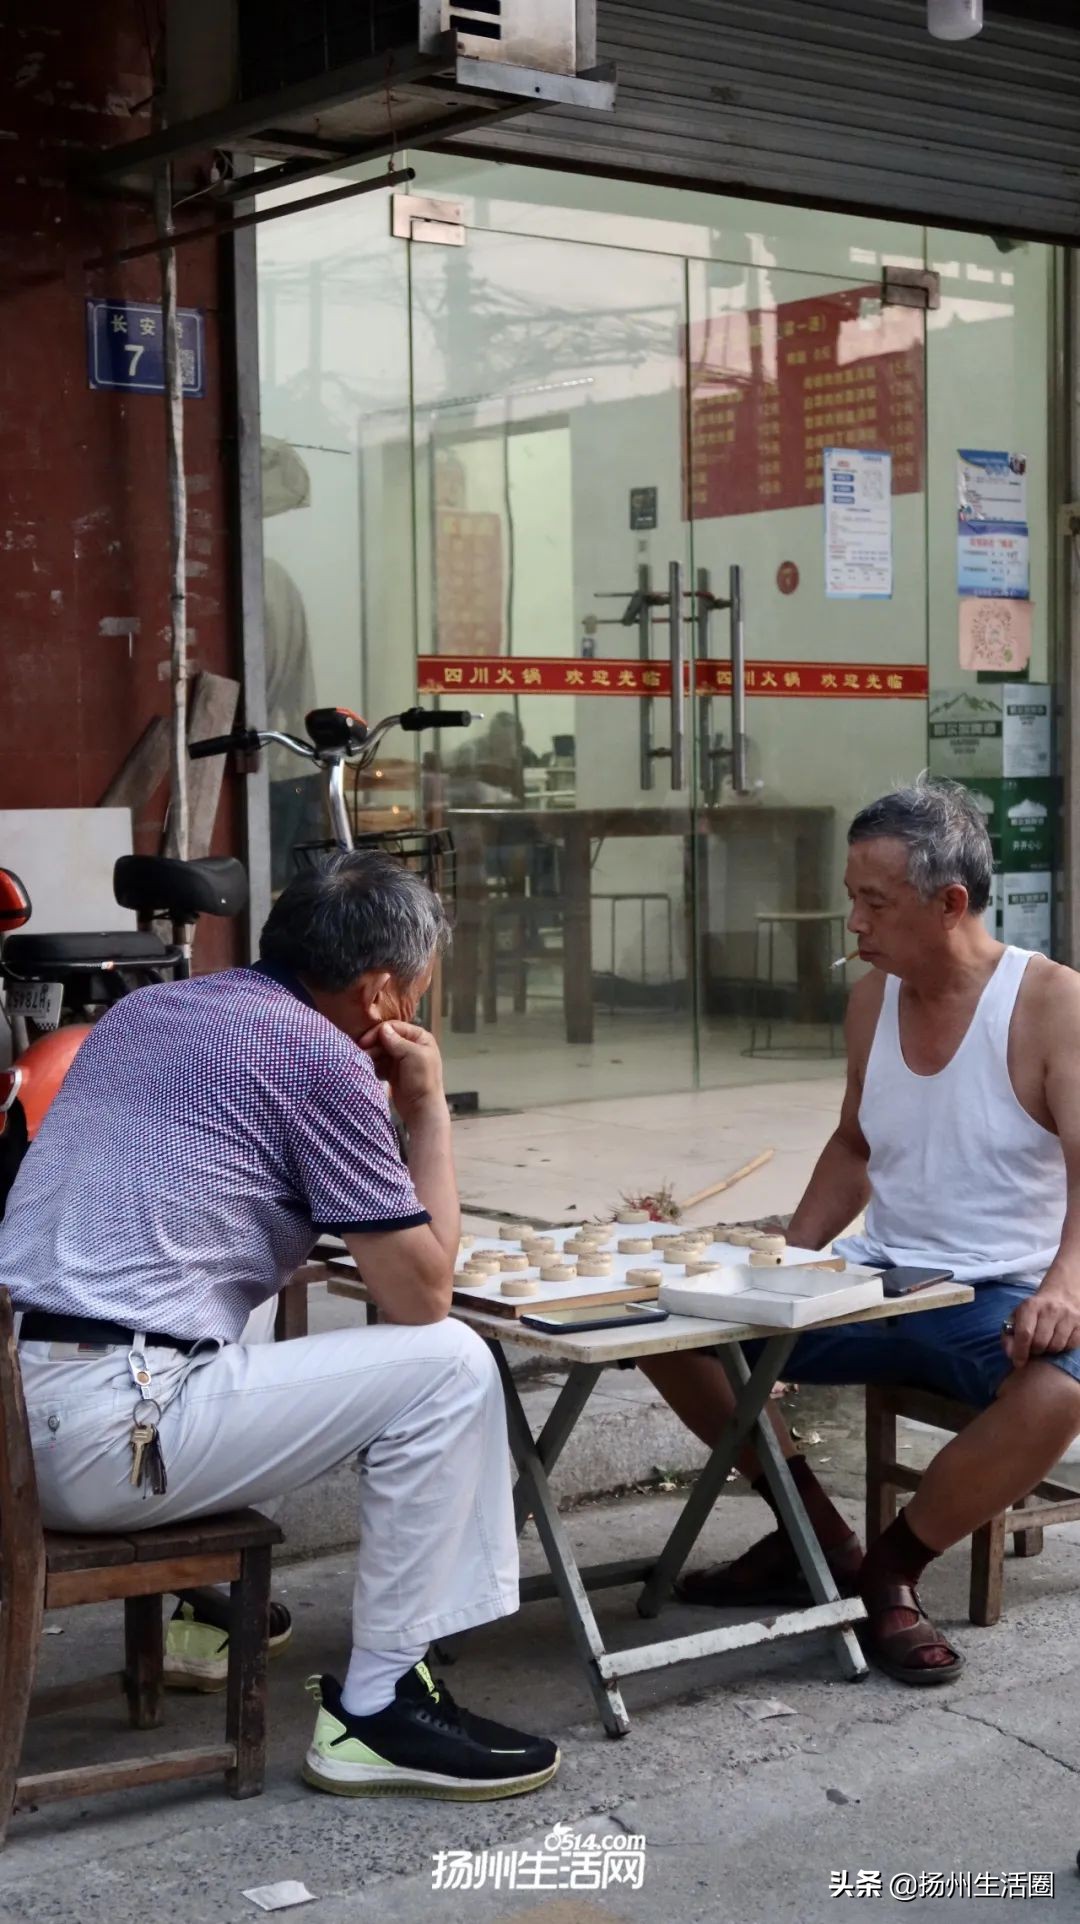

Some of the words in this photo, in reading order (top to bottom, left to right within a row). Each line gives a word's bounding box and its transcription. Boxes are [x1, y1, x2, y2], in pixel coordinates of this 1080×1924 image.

[124, 344, 144, 376] 7
[444, 667, 542, 685] 四川火锅
[565, 669, 661, 687] 欢迎光临
[820, 673, 904, 689] 欢迎光临
